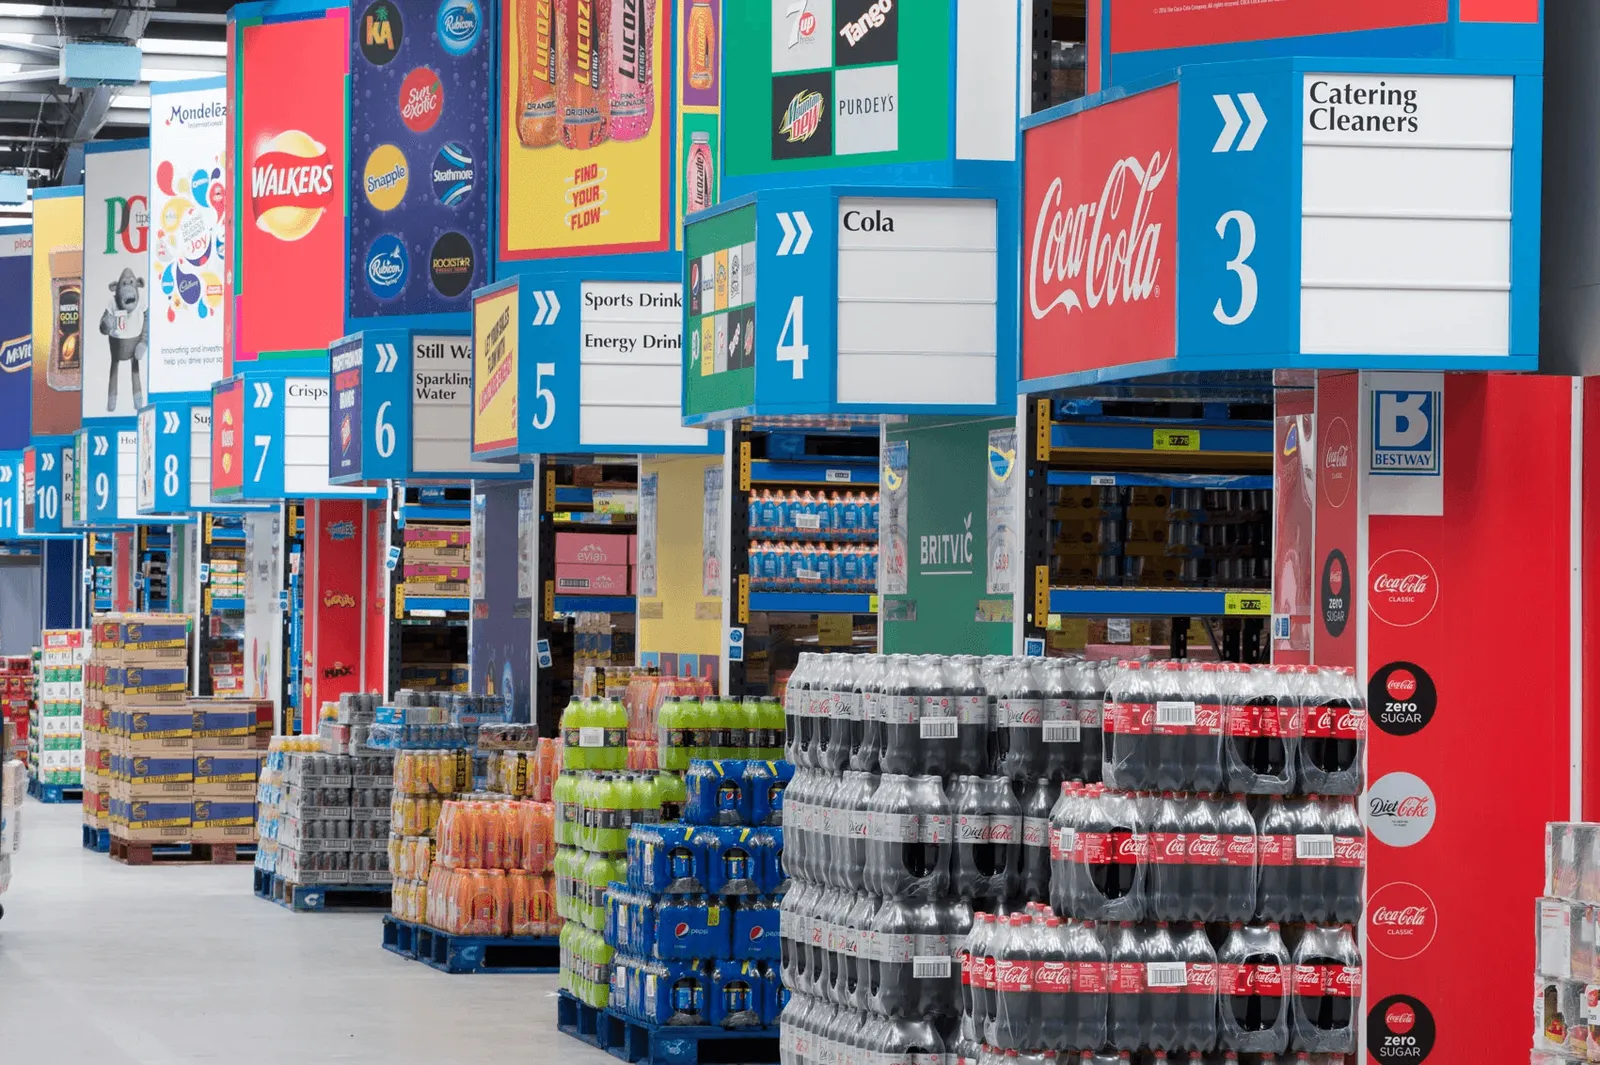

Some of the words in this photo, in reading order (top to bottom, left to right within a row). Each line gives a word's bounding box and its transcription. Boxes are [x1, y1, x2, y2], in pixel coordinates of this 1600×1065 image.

[366, 15, 395, 50] KA
[445, 15, 474, 31] Rubicon
[839, 0, 893, 47] Tango
[408, 86, 431, 104] Sun
[839, 93, 894, 115] PURDEY'S
[1309, 81, 1418, 113] Catering
[527, 100, 556, 110] ORANGE
[565, 107, 599, 116] ORIGINAL
[1309, 107, 1419, 133] Cleaners
[252, 163, 334, 198] WALKERS
[367, 165, 406, 193] Snapple
[433, 170, 474, 183] Strathmore
[574, 163, 598, 185] FIND
[572, 185, 600, 207] YOUR
[571, 207, 600, 230] FLOW
[843, 210, 894, 232] Cola
[1028, 147, 1173, 320] Coca-Cola
[371, 259, 401, 276] Rubicon
[1212, 210, 1258, 325] 3
[585, 293, 633, 310] Sports
[60, 312, 79, 321] GOLD
[585, 334, 637, 352] Energy
[776, 296, 809, 379] 4
[416, 344, 444, 359] Still
[288, 384, 328, 403] Crisps
[416, 387, 456, 400] Water
[532, 363, 555, 430] 5
[375, 400, 396, 459] 6
[253, 435, 272, 482] 7
[1326, 445, 1349, 468] Coca-Cola
[1374, 451, 1432, 466] BESTWAY
[163, 454, 179, 497] 8
[95, 472, 109, 510] 9
[37, 485, 58, 519] 10
[577, 551, 607, 561] evian
[592, 580, 615, 589] evian
[1374, 574, 1429, 593] Coca-Cola
[1329, 599, 1343, 609] zero
[1326, 609, 1345, 622] SUGAR
[1387, 680, 1415, 690] Coca-Cola
[1385, 702, 1417, 712] zero
[1381, 713, 1422, 723] SUGAR
[1370, 797, 1398, 817] Diet
[1397, 796, 1430, 818] Coke
[1372, 906, 1428, 926] Coca-Cola
[691, 928, 709, 936] pepsi
[1386, 1013, 1413, 1024] Coca-Cola
[1384, 1036, 1416, 1046] zero
[1379, 1046, 1421, 1057] SUGAR
